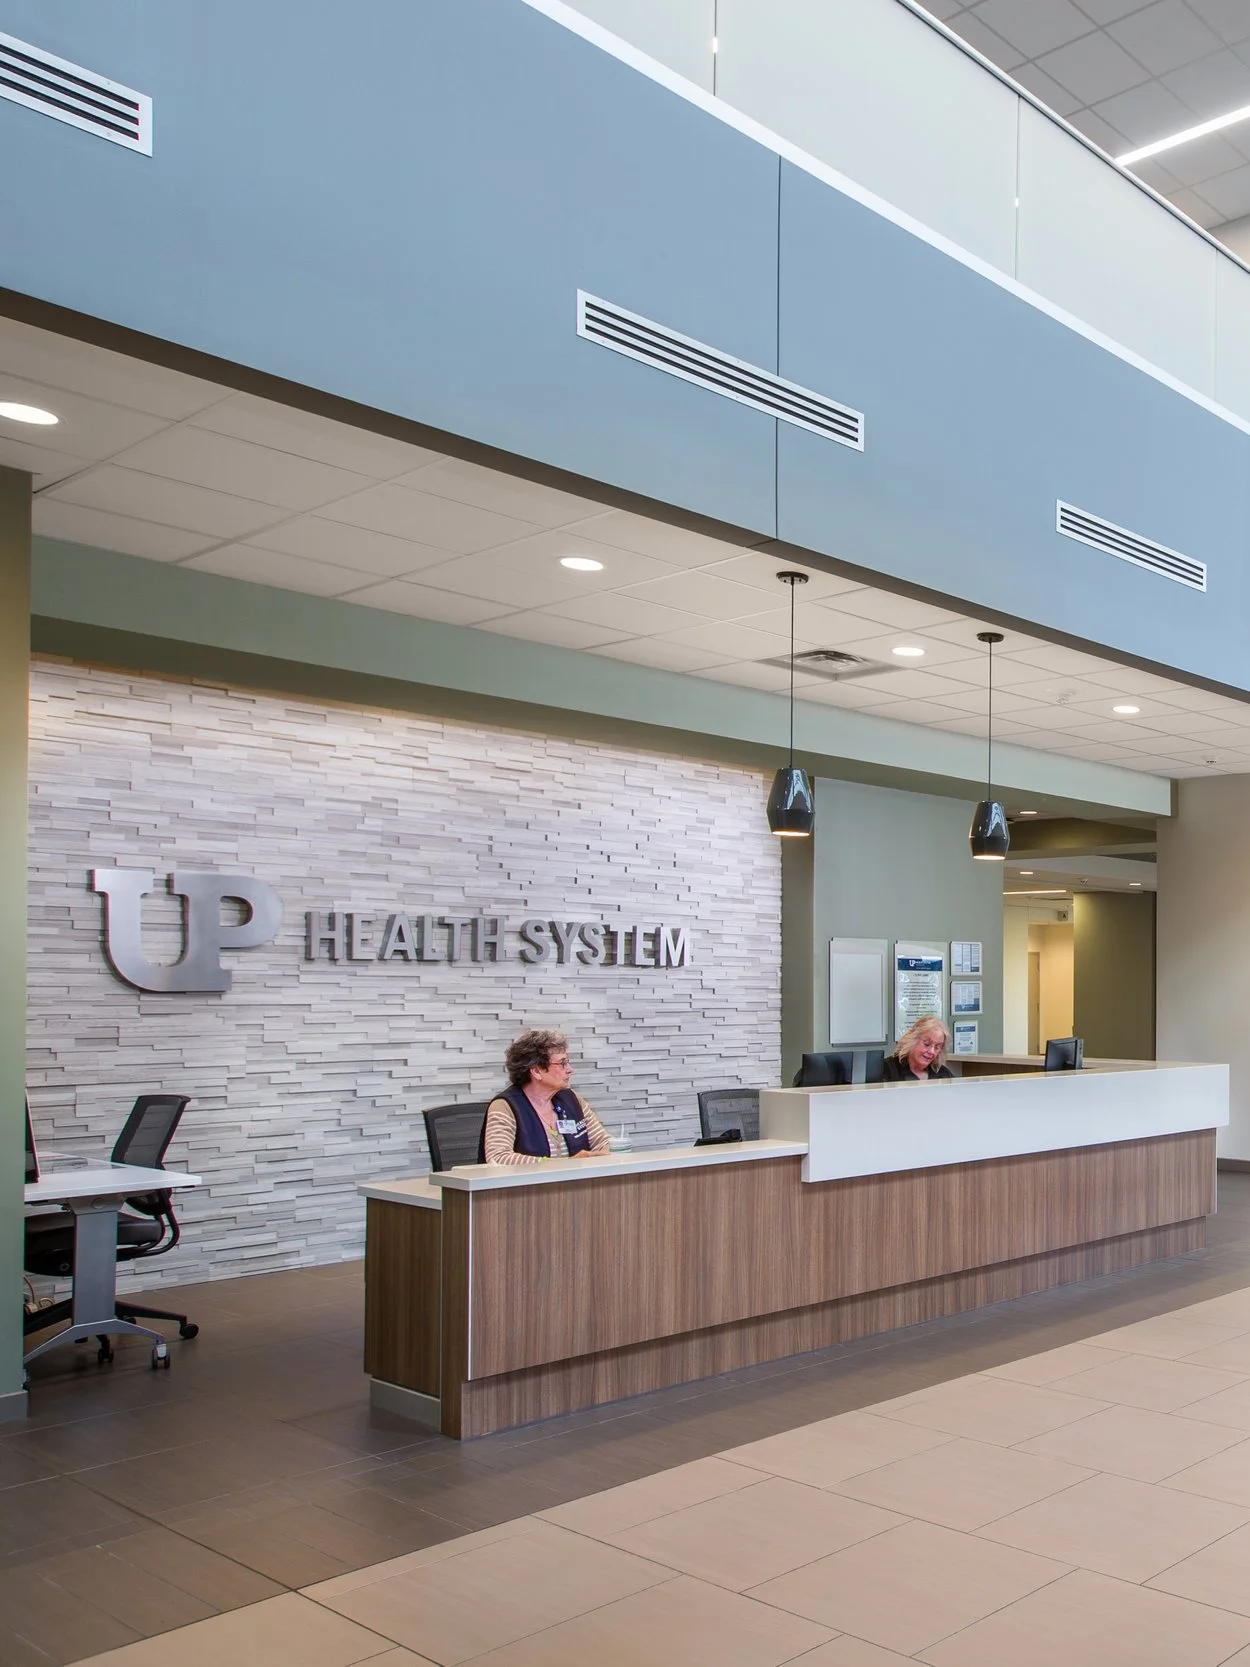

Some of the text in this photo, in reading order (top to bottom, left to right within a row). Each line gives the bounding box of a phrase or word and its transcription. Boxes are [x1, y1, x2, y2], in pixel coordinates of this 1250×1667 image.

[89, 868, 691, 992] UP HEALTH SYSTEM
